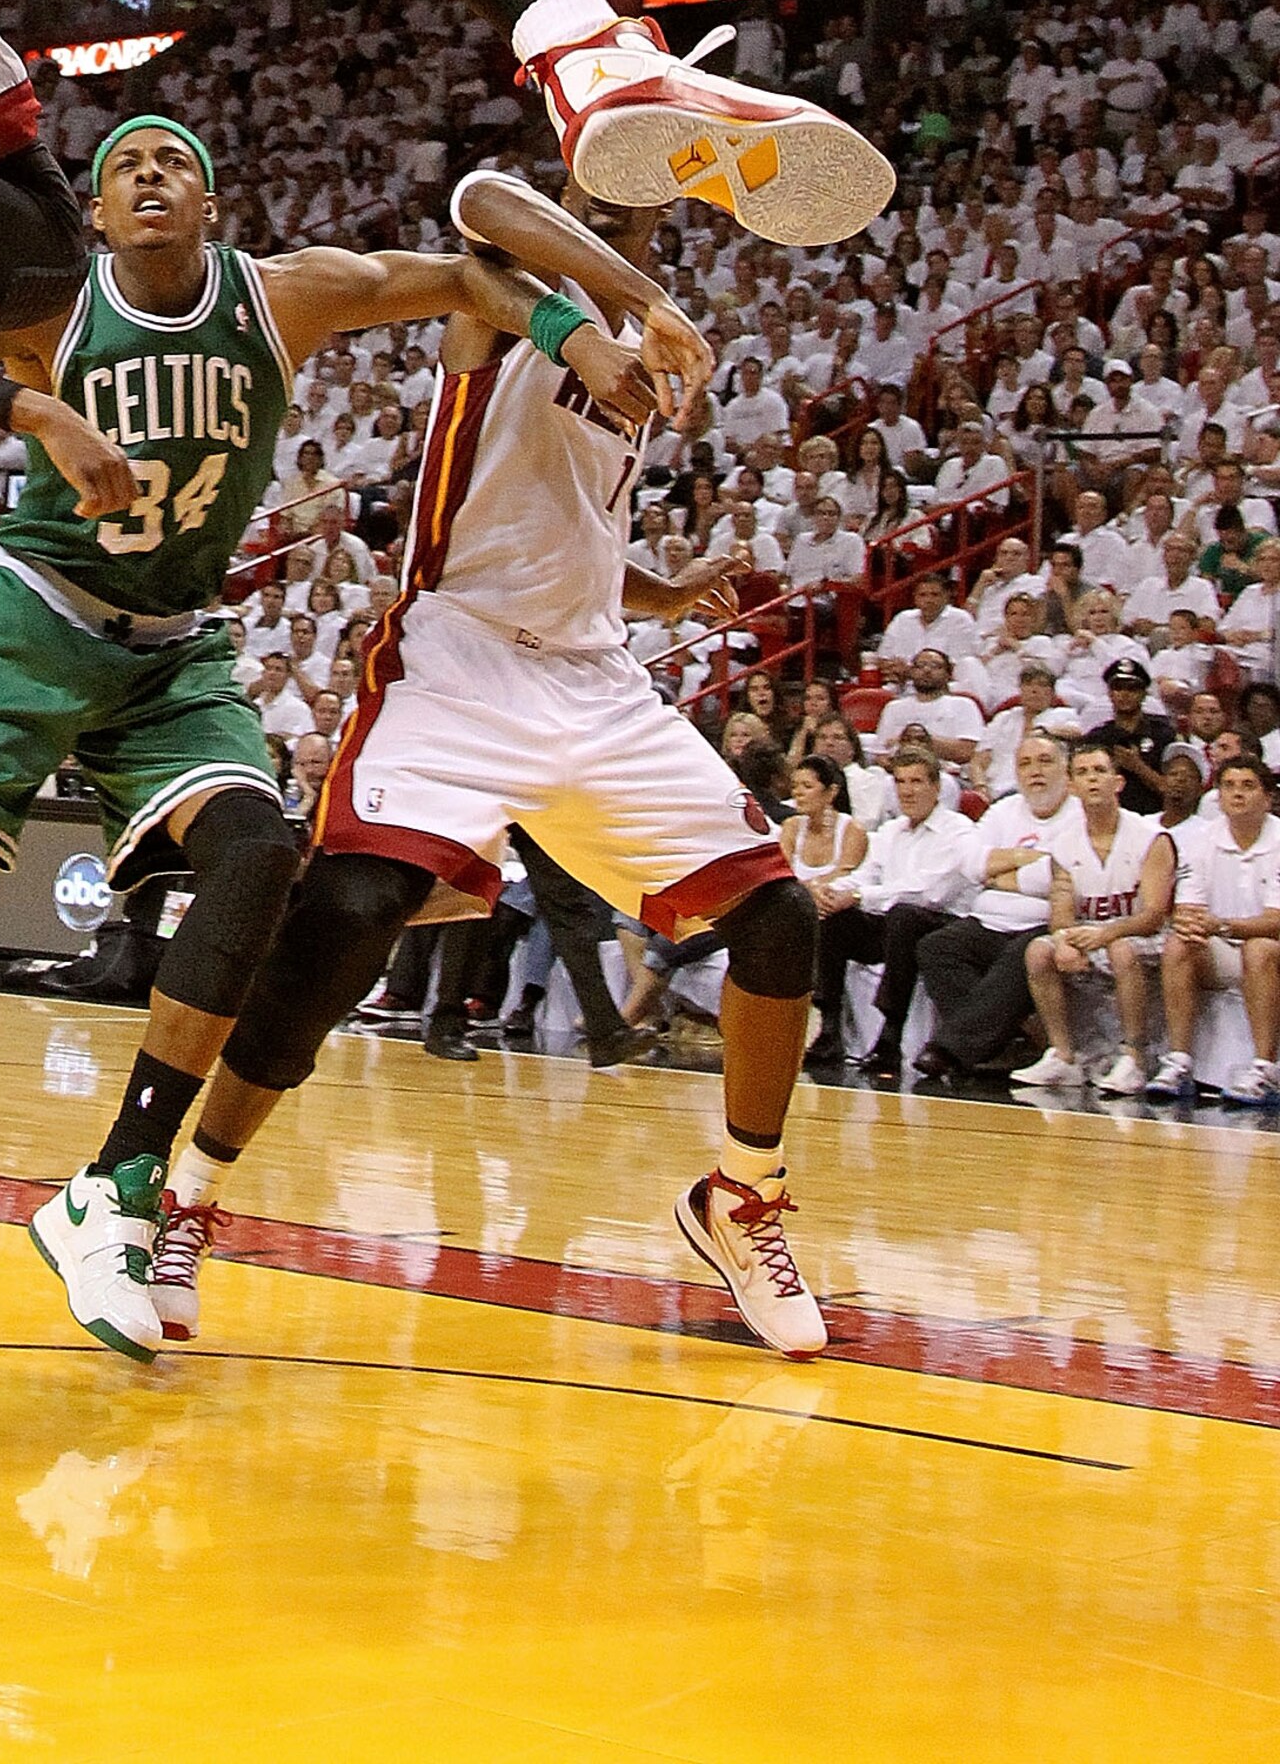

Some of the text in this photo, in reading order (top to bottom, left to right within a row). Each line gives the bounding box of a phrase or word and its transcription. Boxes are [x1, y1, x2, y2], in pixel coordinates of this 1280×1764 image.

[84, 354, 253, 449] CELTICS
[96, 452, 229, 554] 34
[55, 871, 113, 908] abc
[1075, 887, 1139, 921] HEAT
